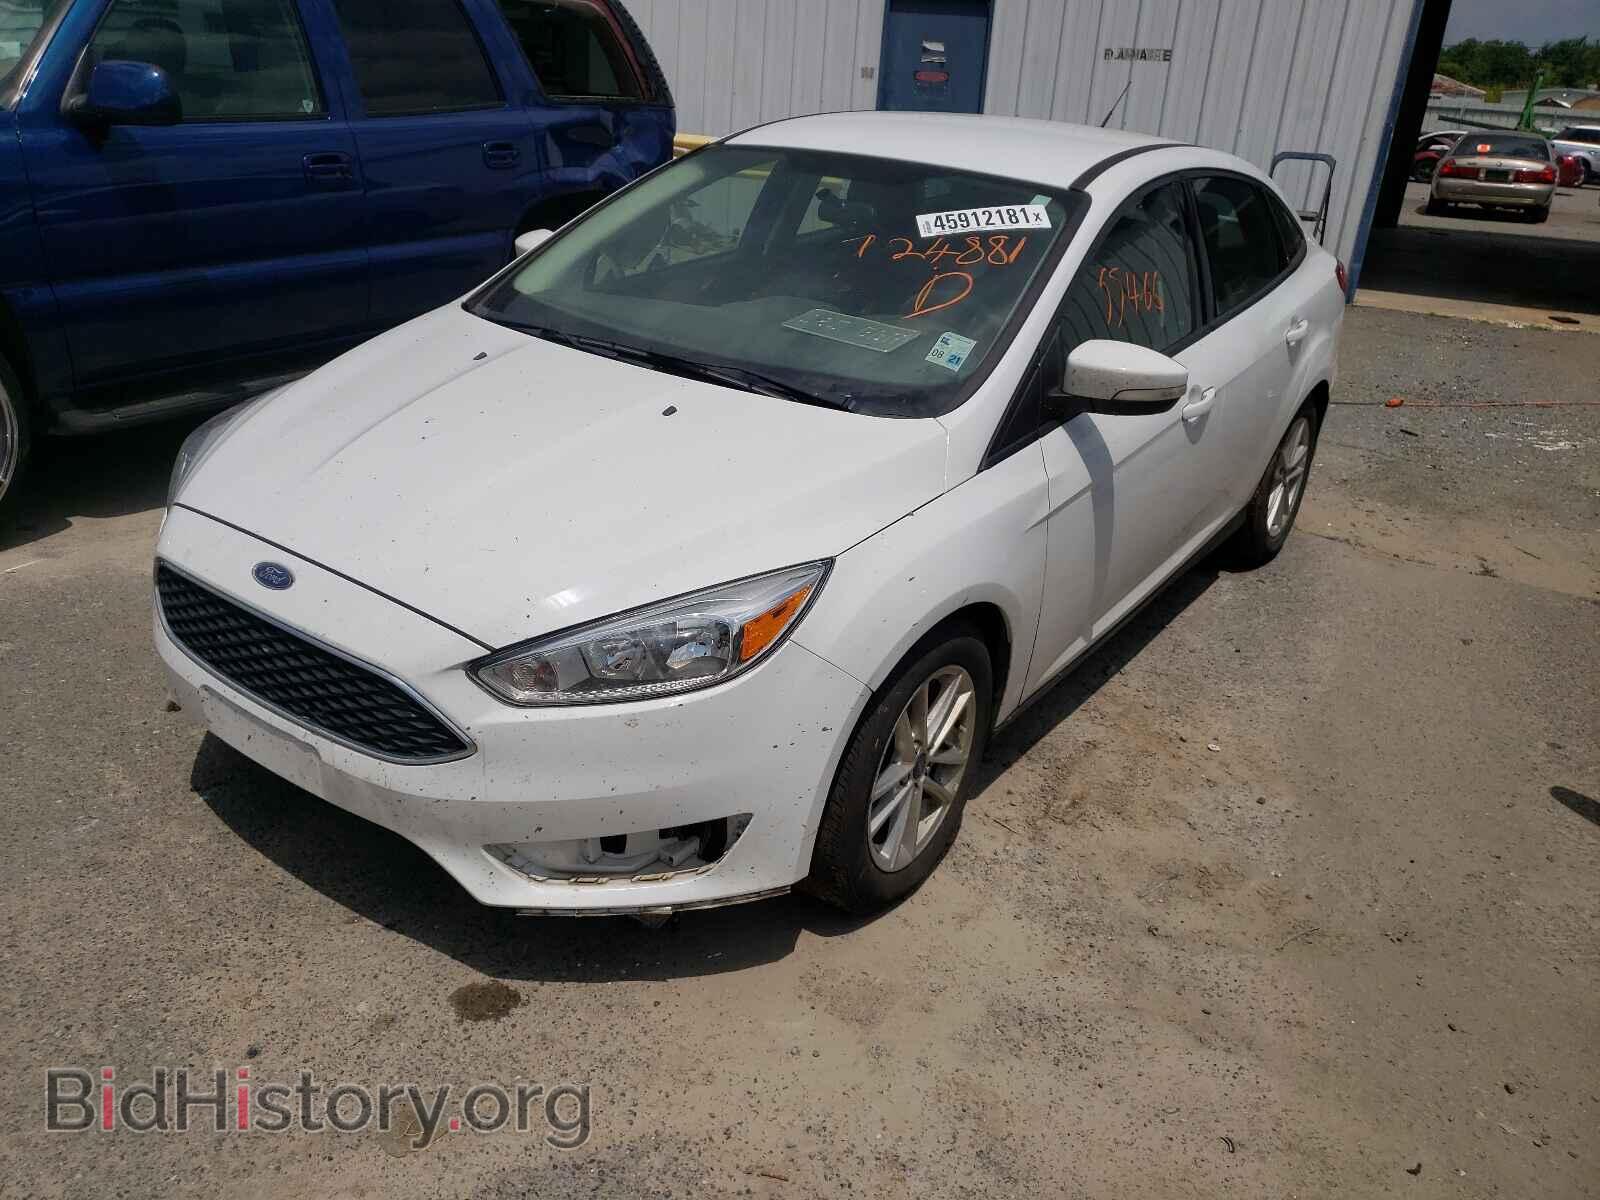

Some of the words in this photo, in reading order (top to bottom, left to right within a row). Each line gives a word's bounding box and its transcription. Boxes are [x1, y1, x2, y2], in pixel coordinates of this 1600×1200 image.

[934, 207, 1030, 231] 45912181
[931, 348, 945, 359] 08
[948, 354, 961, 365] 21
